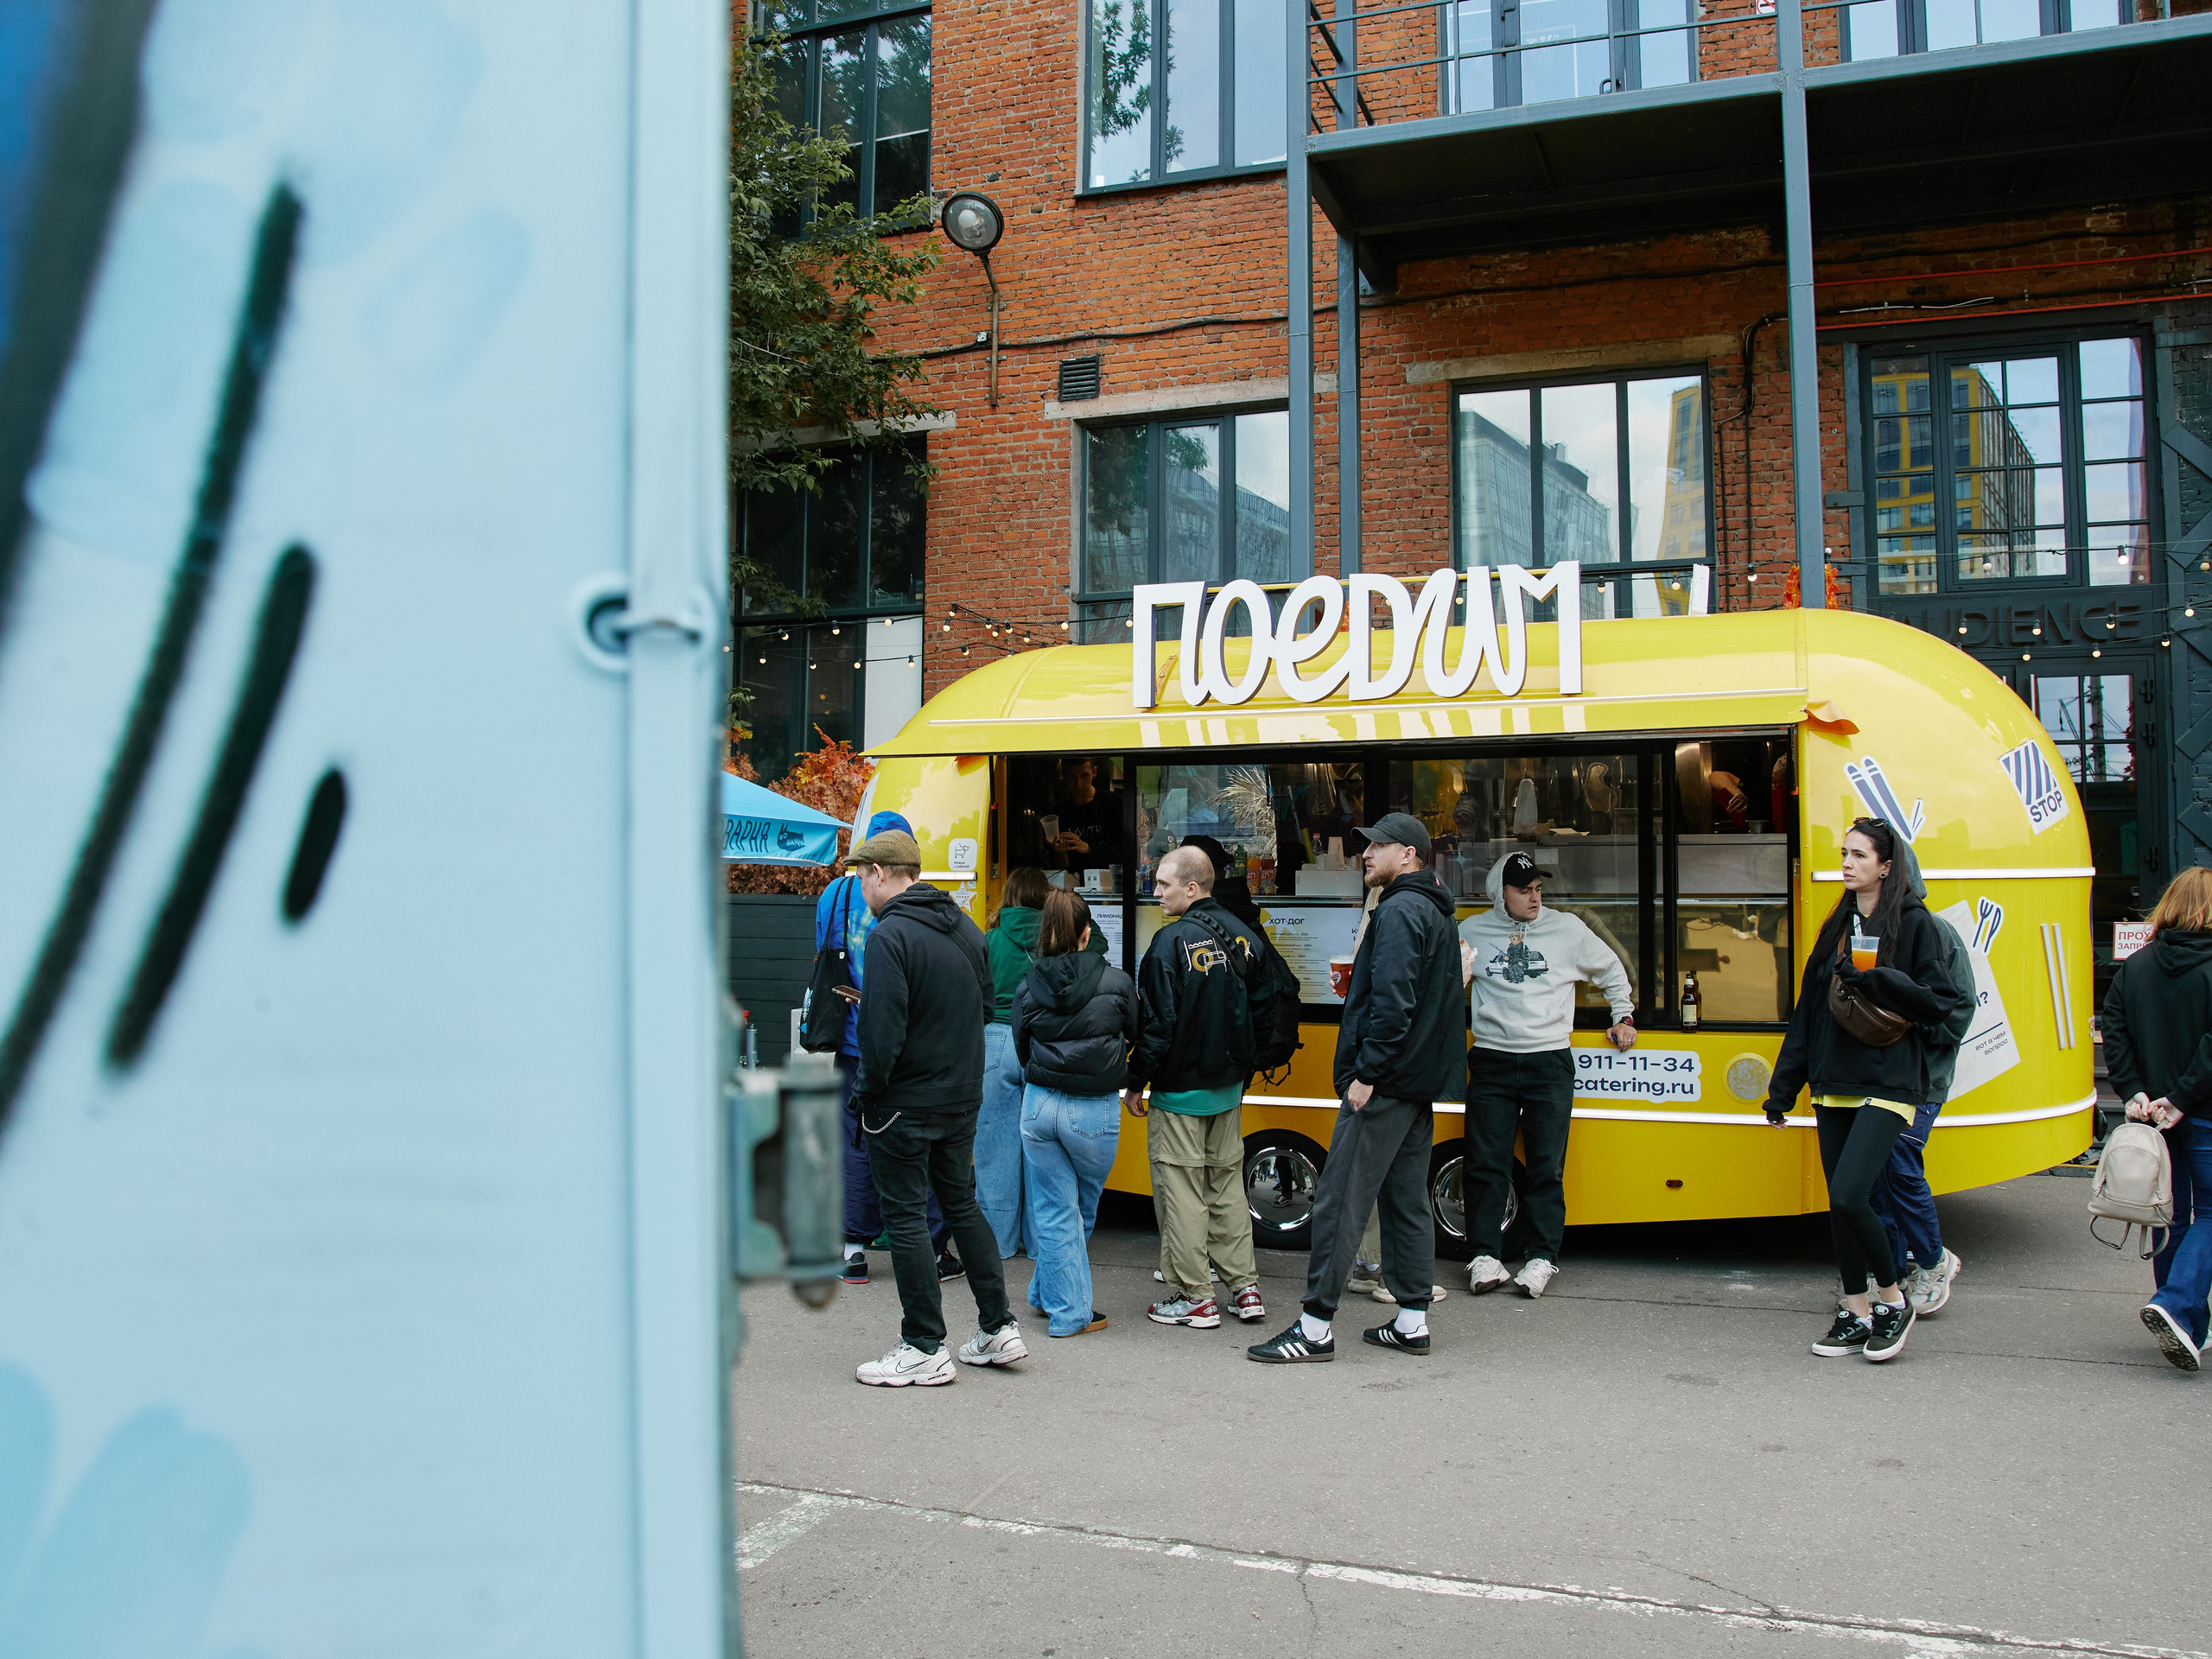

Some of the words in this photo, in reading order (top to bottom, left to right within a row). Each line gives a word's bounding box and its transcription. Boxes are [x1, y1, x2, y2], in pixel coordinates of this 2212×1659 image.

[2030, 790, 2063, 823] STOP
[722, 818, 772, 854] ВАРНЯ
[1067, 824, 1104, 838] OUTH
[2118, 931, 2152, 941] ПРОХ
[1984, 1039, 2009, 1055] вопрос
[1578, 1054, 1694, 1072] 911-11-34
[1573, 1077, 1694, 1096] catering.ru
